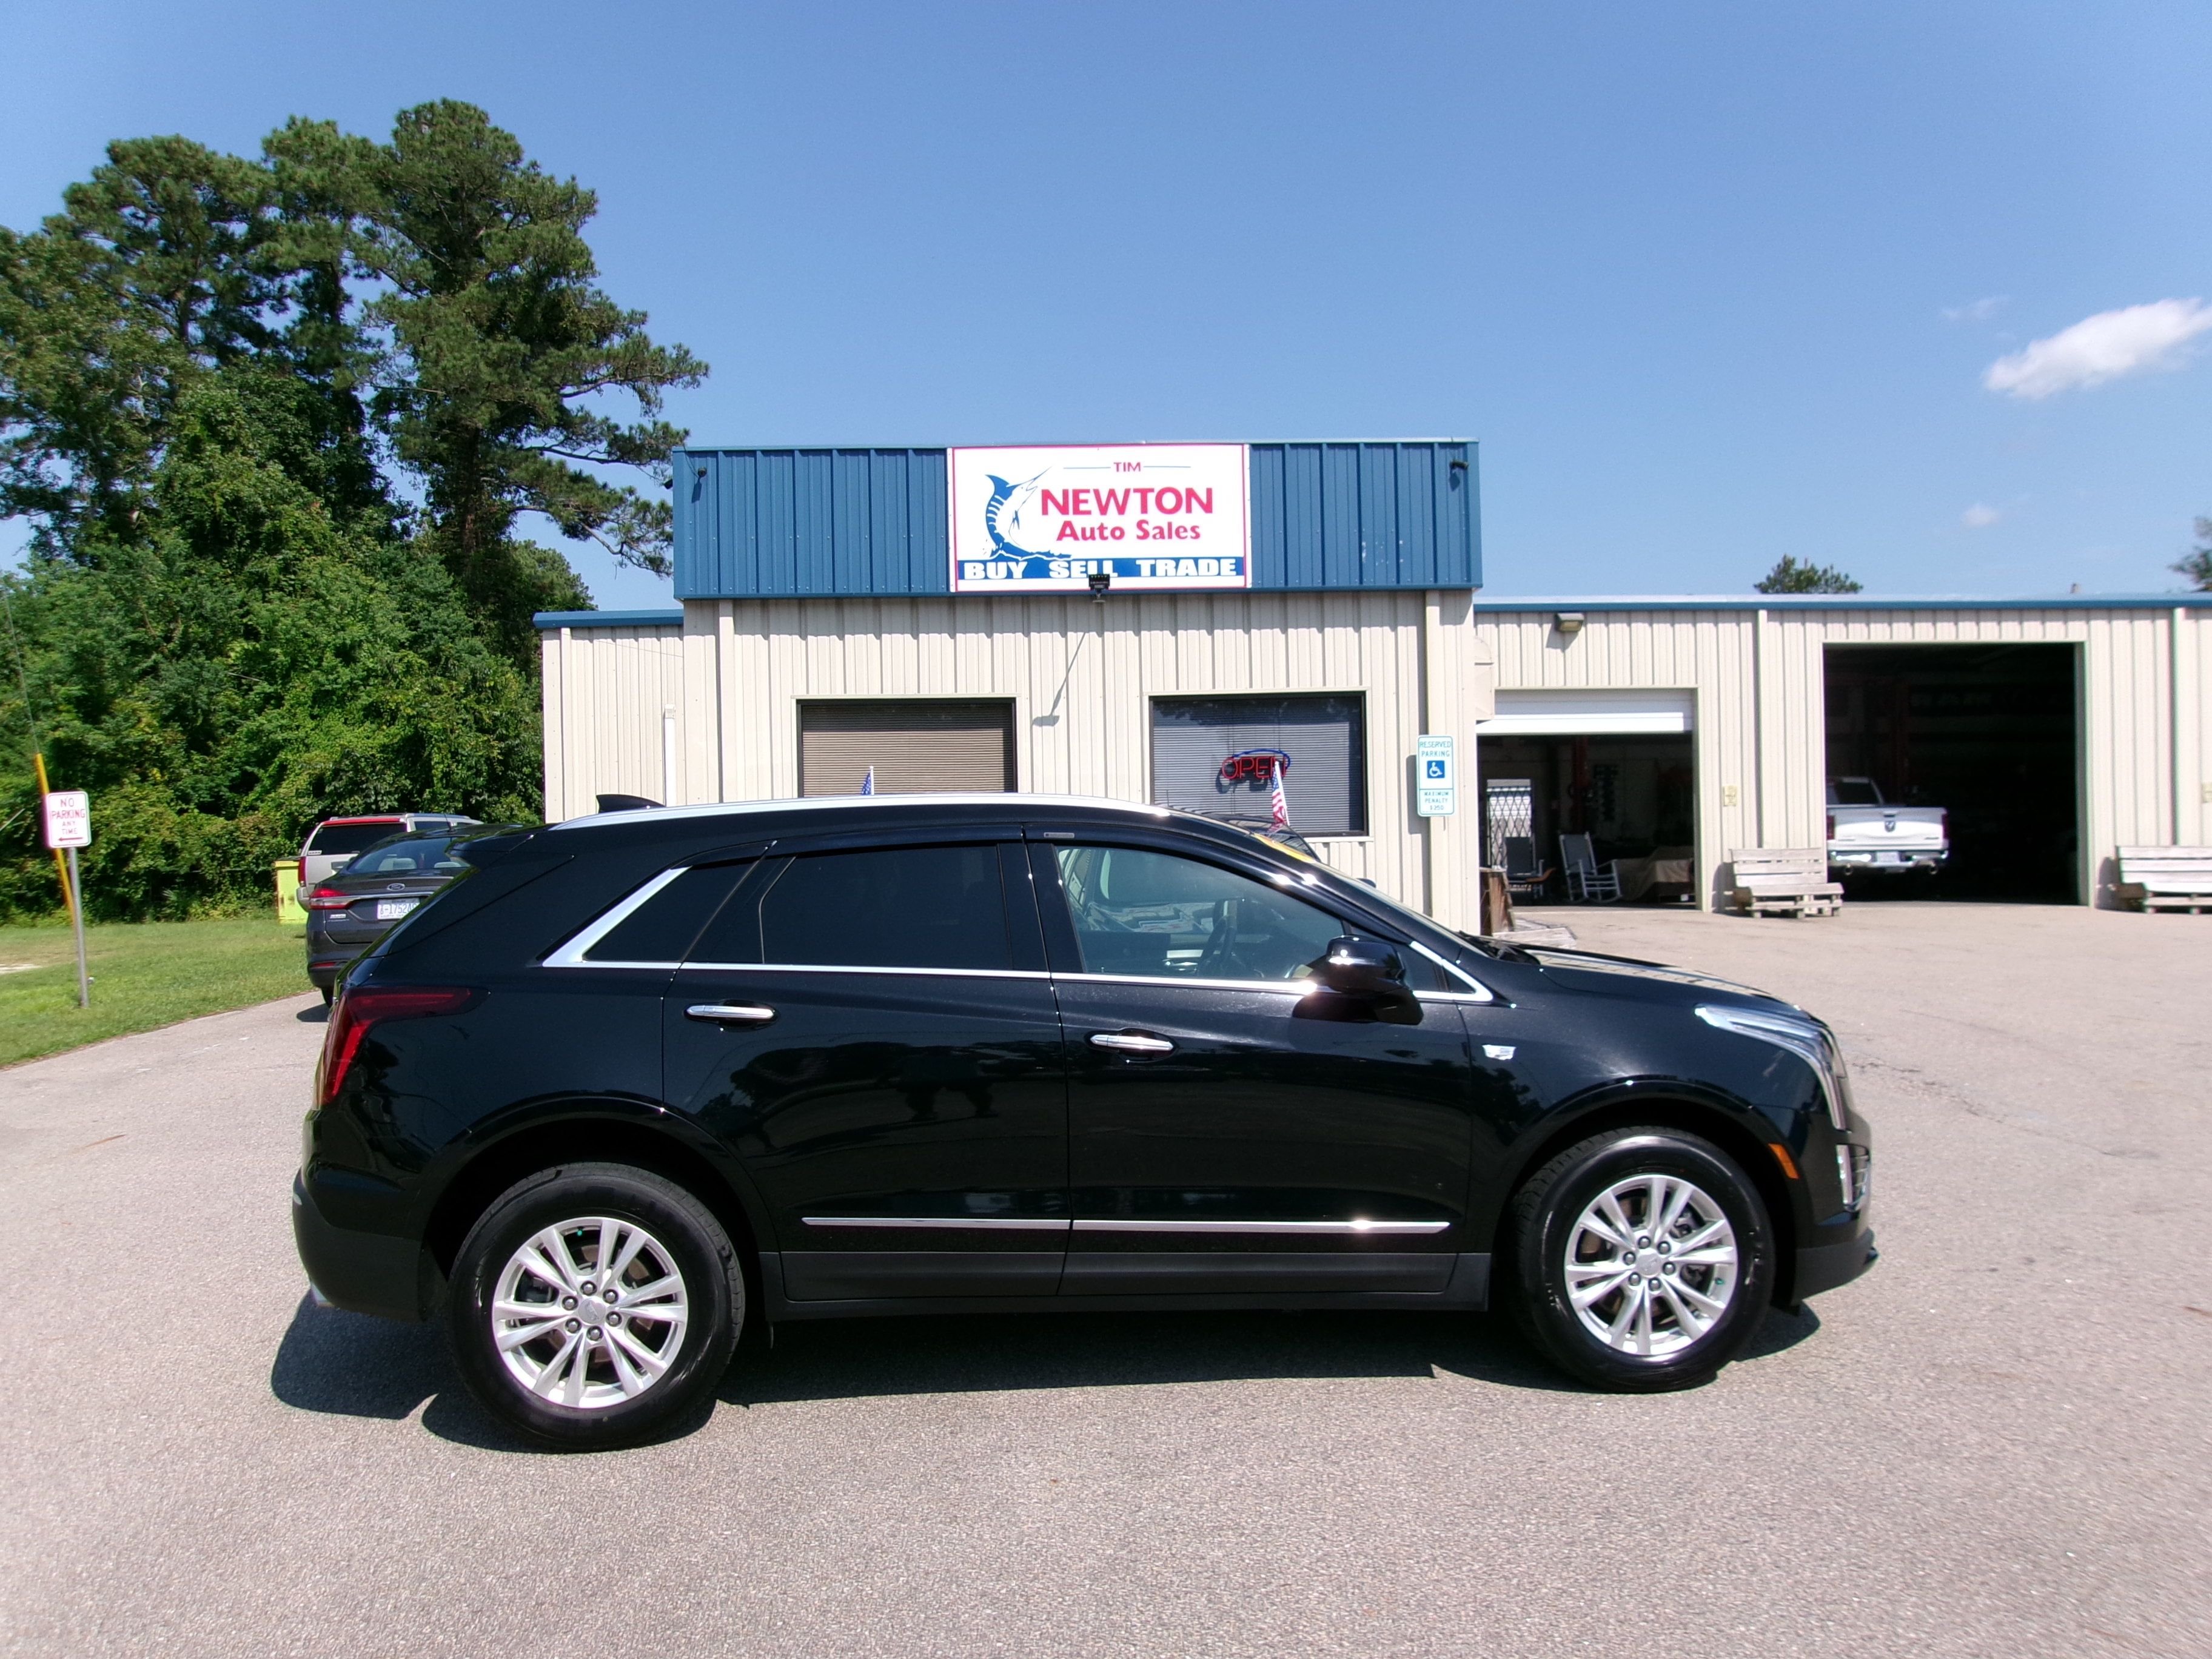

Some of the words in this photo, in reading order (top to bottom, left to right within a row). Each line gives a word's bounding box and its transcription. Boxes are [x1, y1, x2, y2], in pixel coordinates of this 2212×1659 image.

[1113, 461, 1141, 472] TIM
[1041, 486, 1213, 516] NEWTON
[1056, 520, 1125, 541] Auto
[1136, 519, 1201, 540] Sales
[964, 561, 1028, 580] BUY
[1049, 560, 1118, 578] SELL
[1136, 558, 1237, 577] TRADE
[61, 798, 74, 807] NO
[52, 809, 85, 819] PARKING
